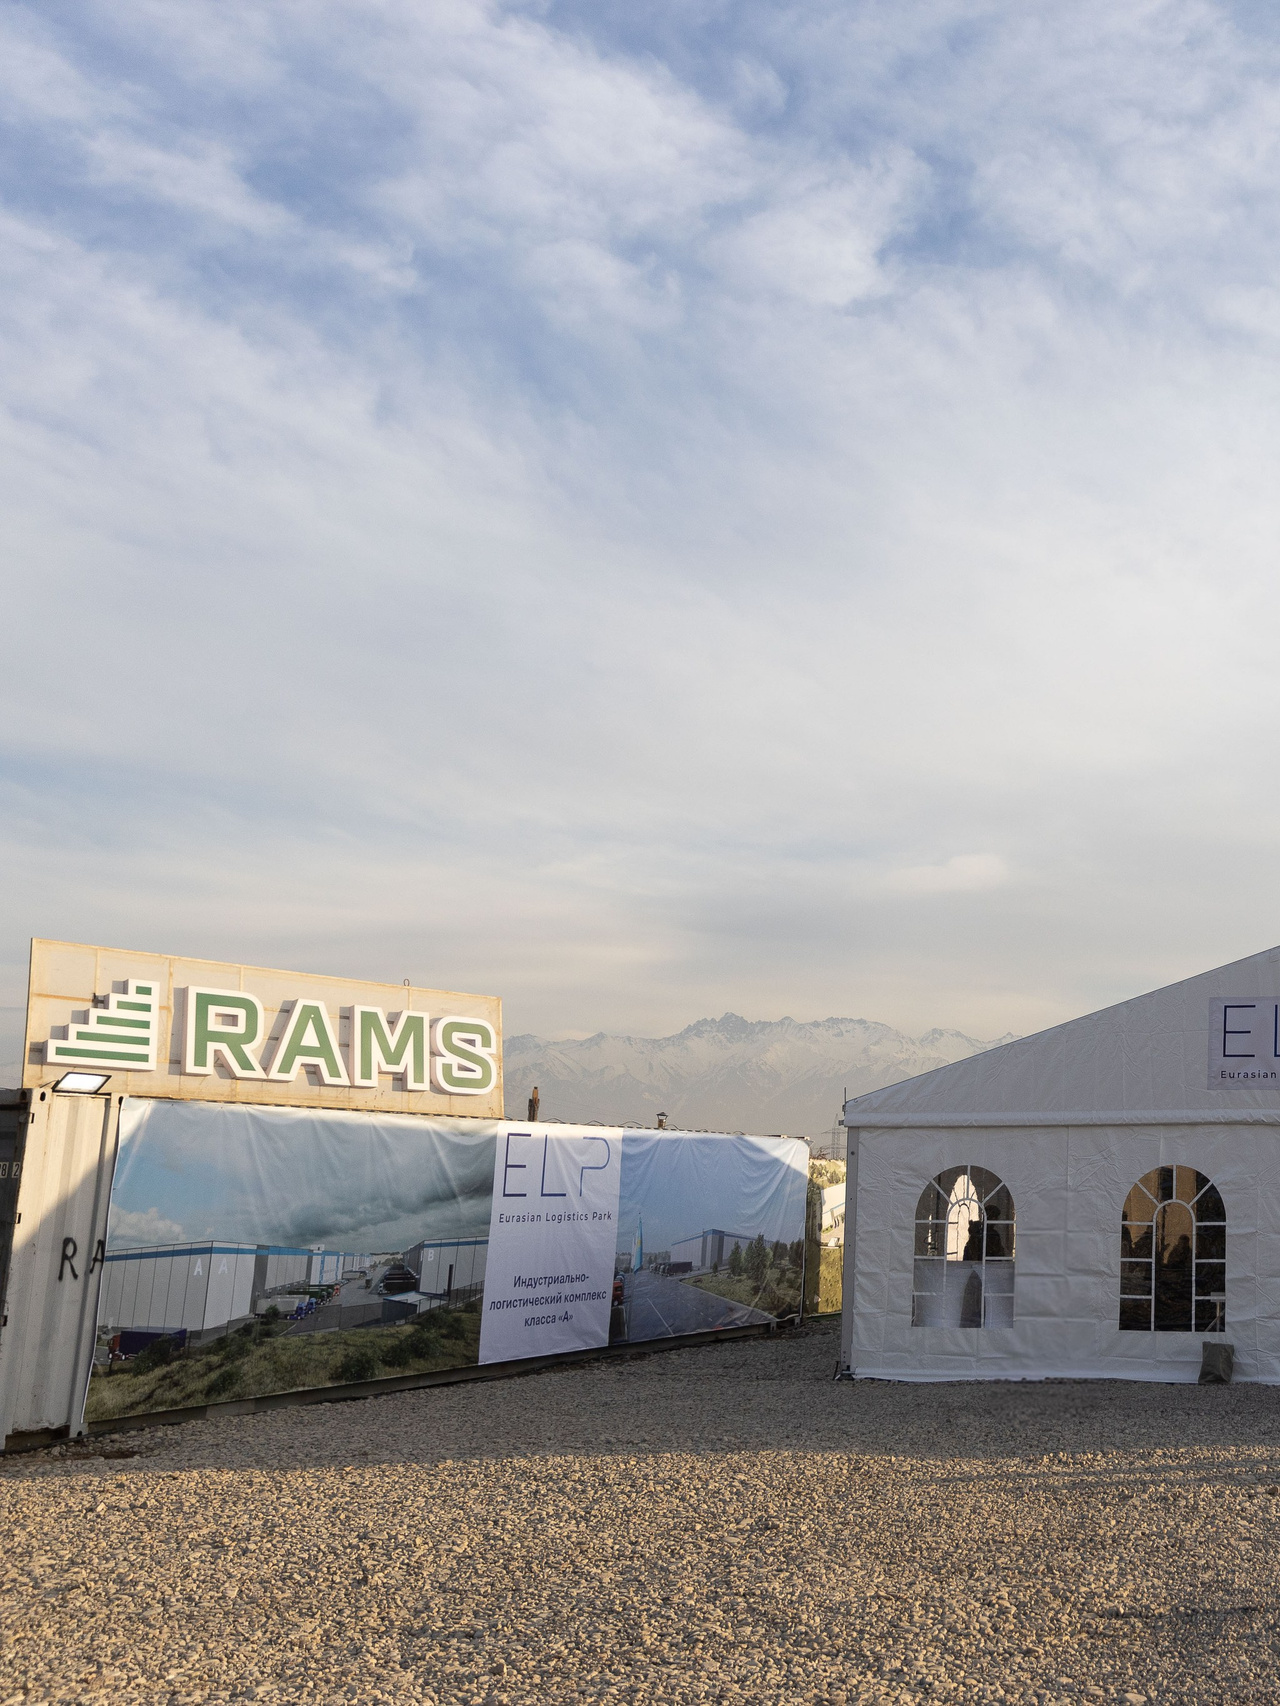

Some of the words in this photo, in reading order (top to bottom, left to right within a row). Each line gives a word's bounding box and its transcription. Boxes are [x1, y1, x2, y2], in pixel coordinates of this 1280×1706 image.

[184, 985, 498, 1095] RAMS
[1220, 1069, 1278, 1079] Eurasian
[502, 1132, 611, 1198] ELP
[498, 1213, 542, 1224] Eurasian
[545, 1211, 589, 1224] Logistics
[592, 1210, 613, 1221] Park
[513, 1273, 590, 1289] Индустриально-
[489, 1291, 562, 1311] логистический
[563, 1290, 607, 1303] комплекс
[524, 1314, 557, 1327] класса
[558, 1310, 574, 1322] «А»
